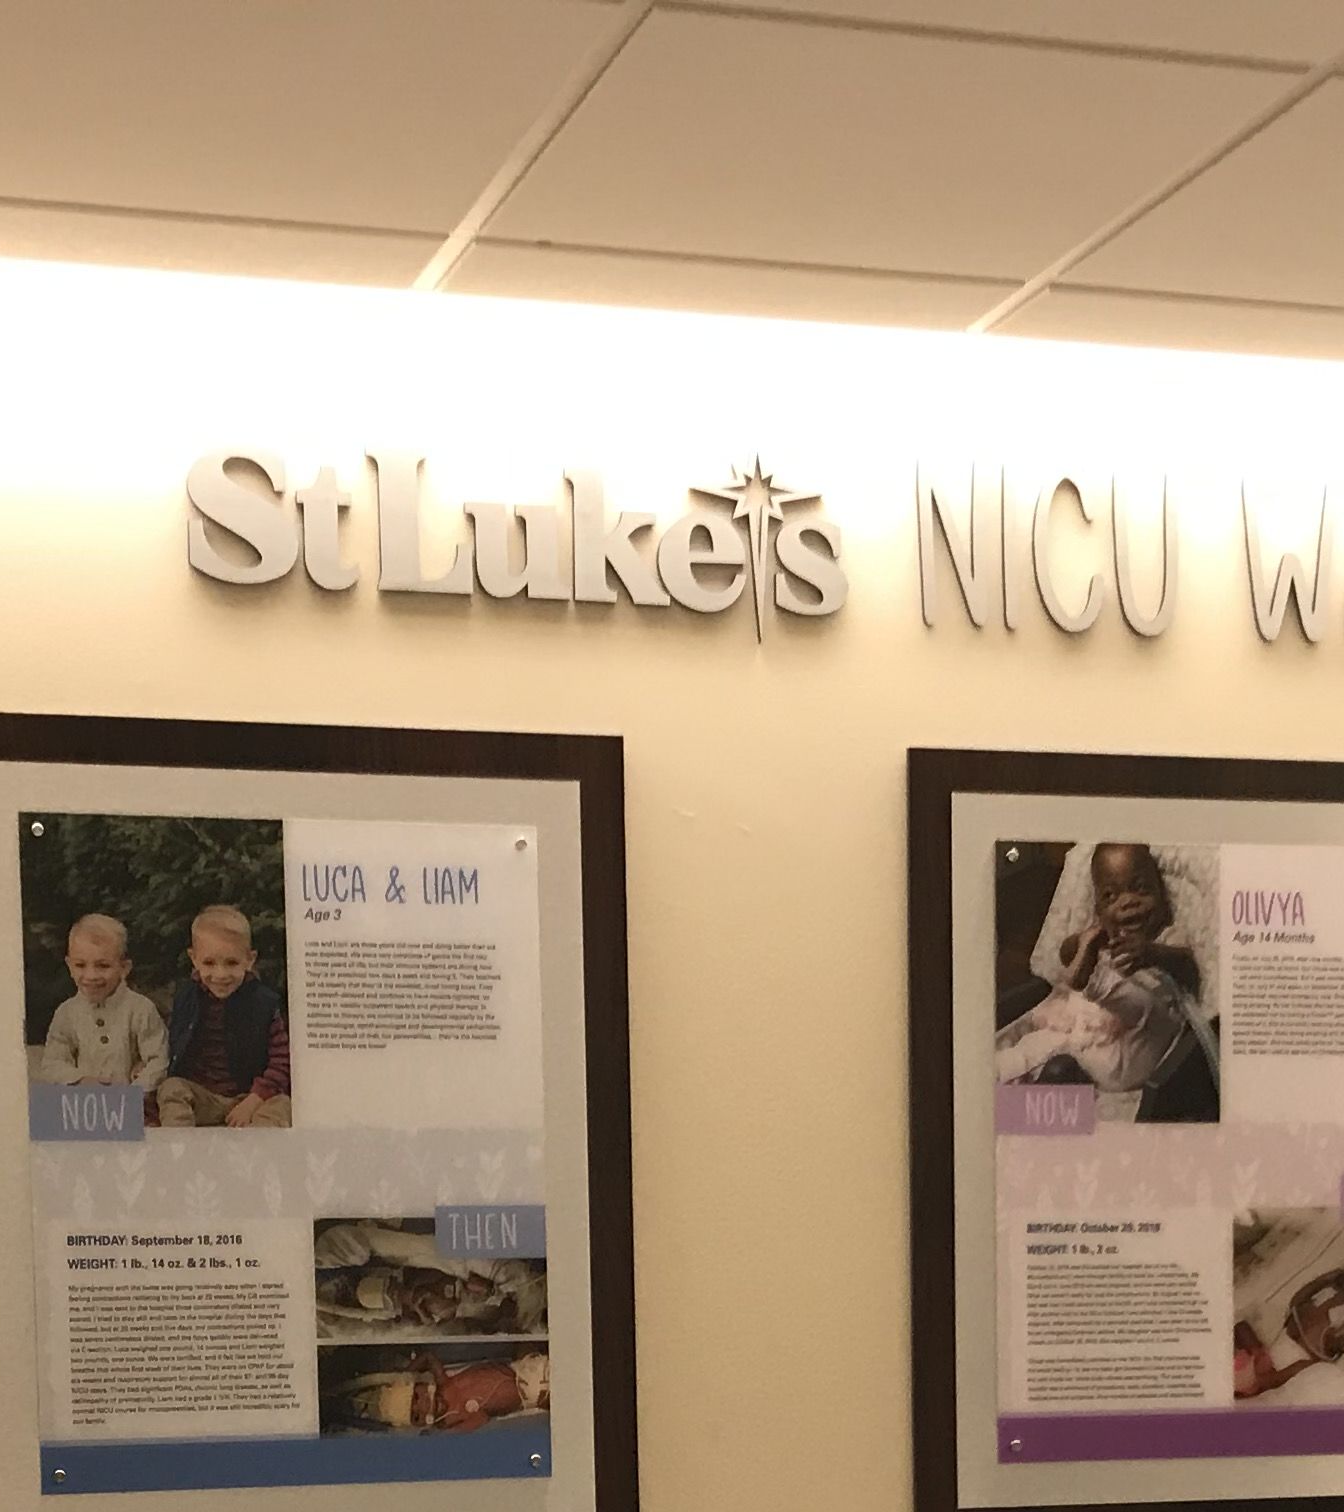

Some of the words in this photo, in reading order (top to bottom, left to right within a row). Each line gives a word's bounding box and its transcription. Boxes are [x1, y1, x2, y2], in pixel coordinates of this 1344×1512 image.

[186, 454, 361, 592] St
[915, 460, 1179, 638] NICU
[301, 863, 367, 905] LUCA
[384, 866, 407, 905] &
[422, 866, 480, 906] LIAM
[304, 907, 331, 924] Age
[333, 907, 343, 922] 3
[1231, 890, 1306, 927] OLIVYA
[1232, 931, 1256, 945] Age
[1273, 931, 1316, 944] Months
[60, 1093, 127, 1133] NOW
[1025, 1092, 1081, 1128] NOW
[131, 1235, 194, 1247] September
[216, 1234, 243, 1245] 2016
[447, 1212, 519, 1252] THEN
[67, 1259, 118, 1270] WEIGHT:
[152, 1258, 165, 1269] 14
[187, 1258, 197, 1269] &
[199, 1258, 207, 1268] 2
